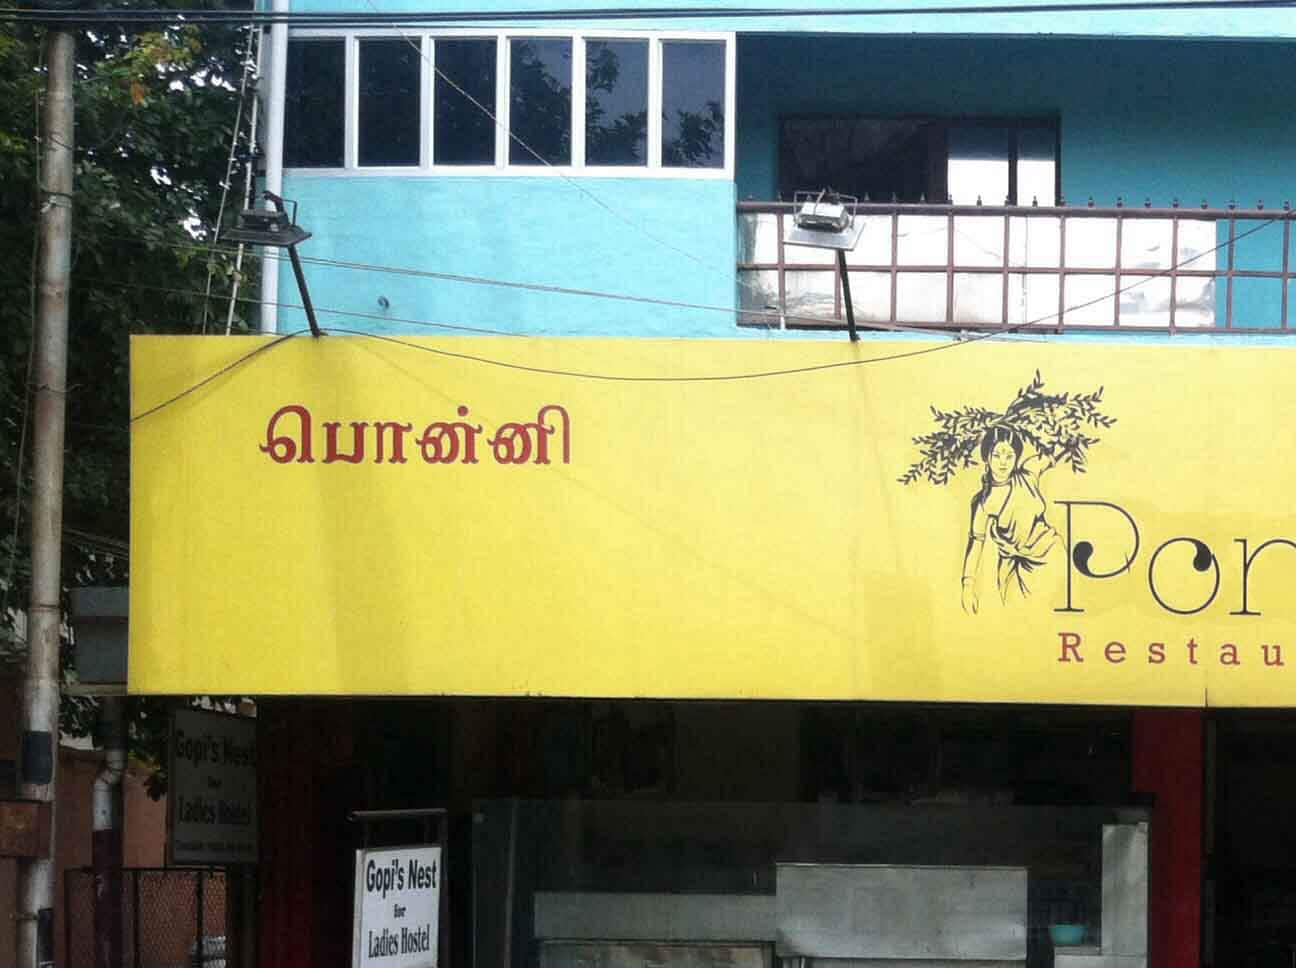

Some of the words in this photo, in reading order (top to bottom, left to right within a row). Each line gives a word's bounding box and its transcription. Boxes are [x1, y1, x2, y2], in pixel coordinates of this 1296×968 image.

[259, 404, 571, 465] பொன்னி
[366, 858, 404, 899] Gopi's
[408, 859, 437, 890] Nest
[367, 928, 399, 958] Ladies
[401, 923, 431, 954] Hostel
